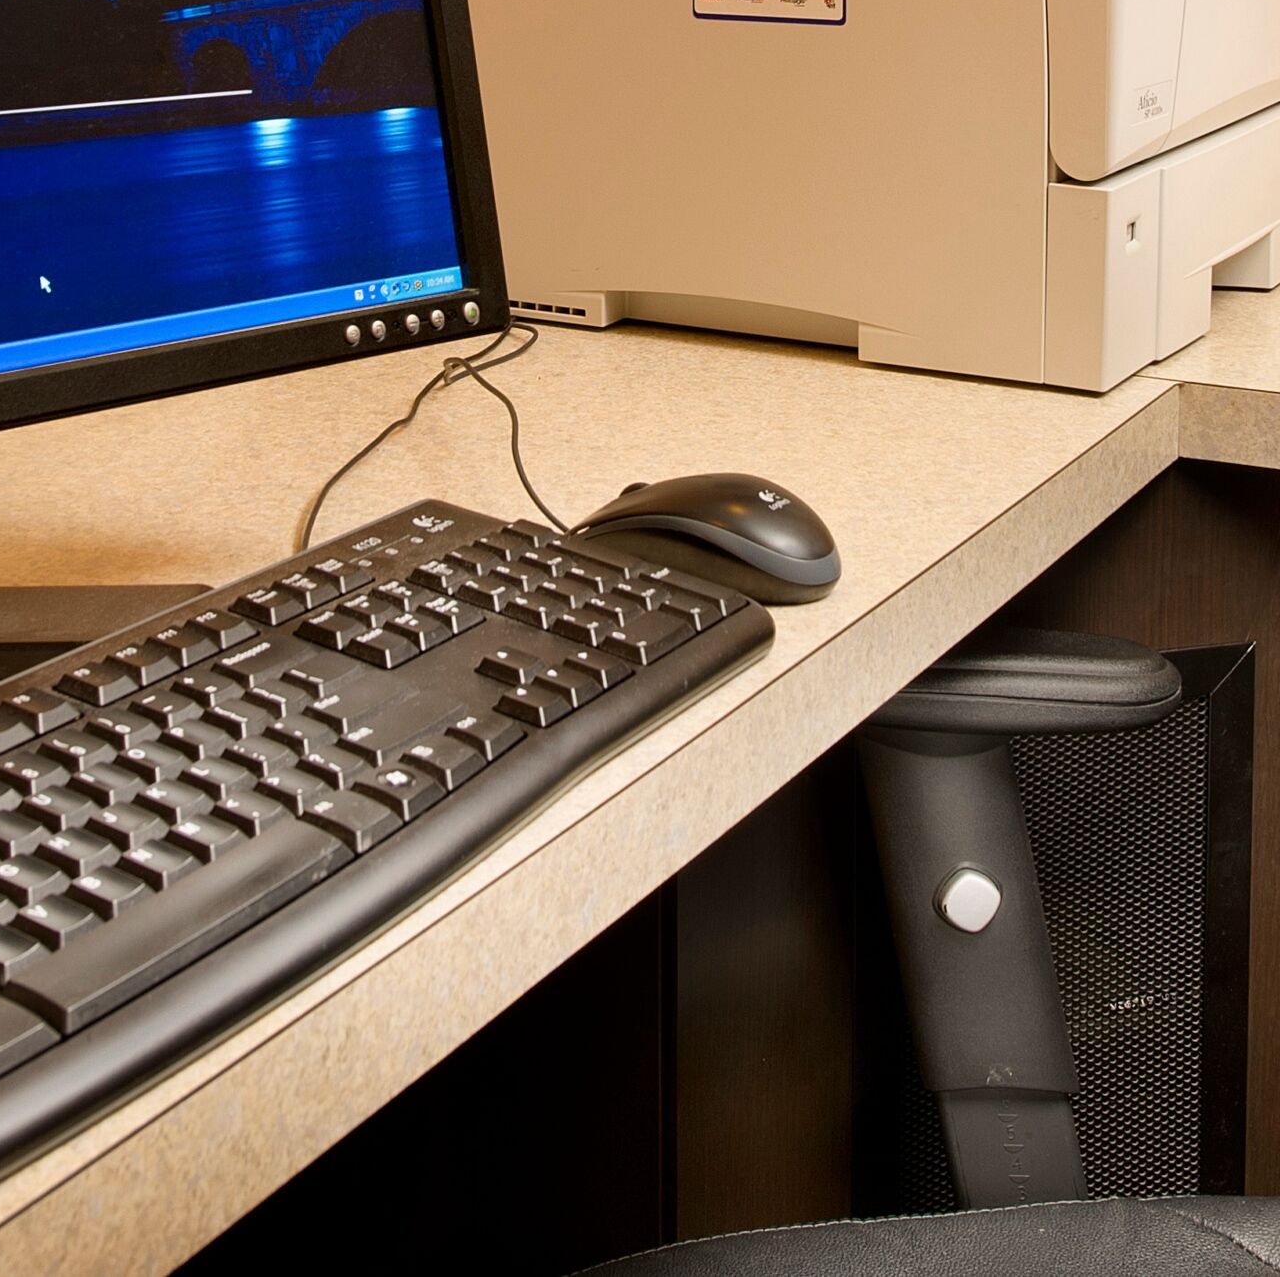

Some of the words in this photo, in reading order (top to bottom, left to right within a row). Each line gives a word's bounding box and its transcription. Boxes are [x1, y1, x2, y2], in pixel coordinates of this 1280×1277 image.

[196, 611, 217, 623] F12
[157, 628, 178, 640] F11
[115, 647, 138, 658] F10
[221, 641, 271, 666] Backspace
[170, 726, 184, 737] P
[127, 748, 146, 760] O
[190, 766, 210, 777] L
[79, 773, 95, 783] I
[145, 787, 167, 799] K
[31, 793, 52, 806] U
[102, 811, 118, 824] J
[178, 822, 201, 836] M
[47, 835, 71, 850] H
[129, 848, 153, 862] N
[79, 875, 102, 890] B
[27, 904, 48, 919] V
